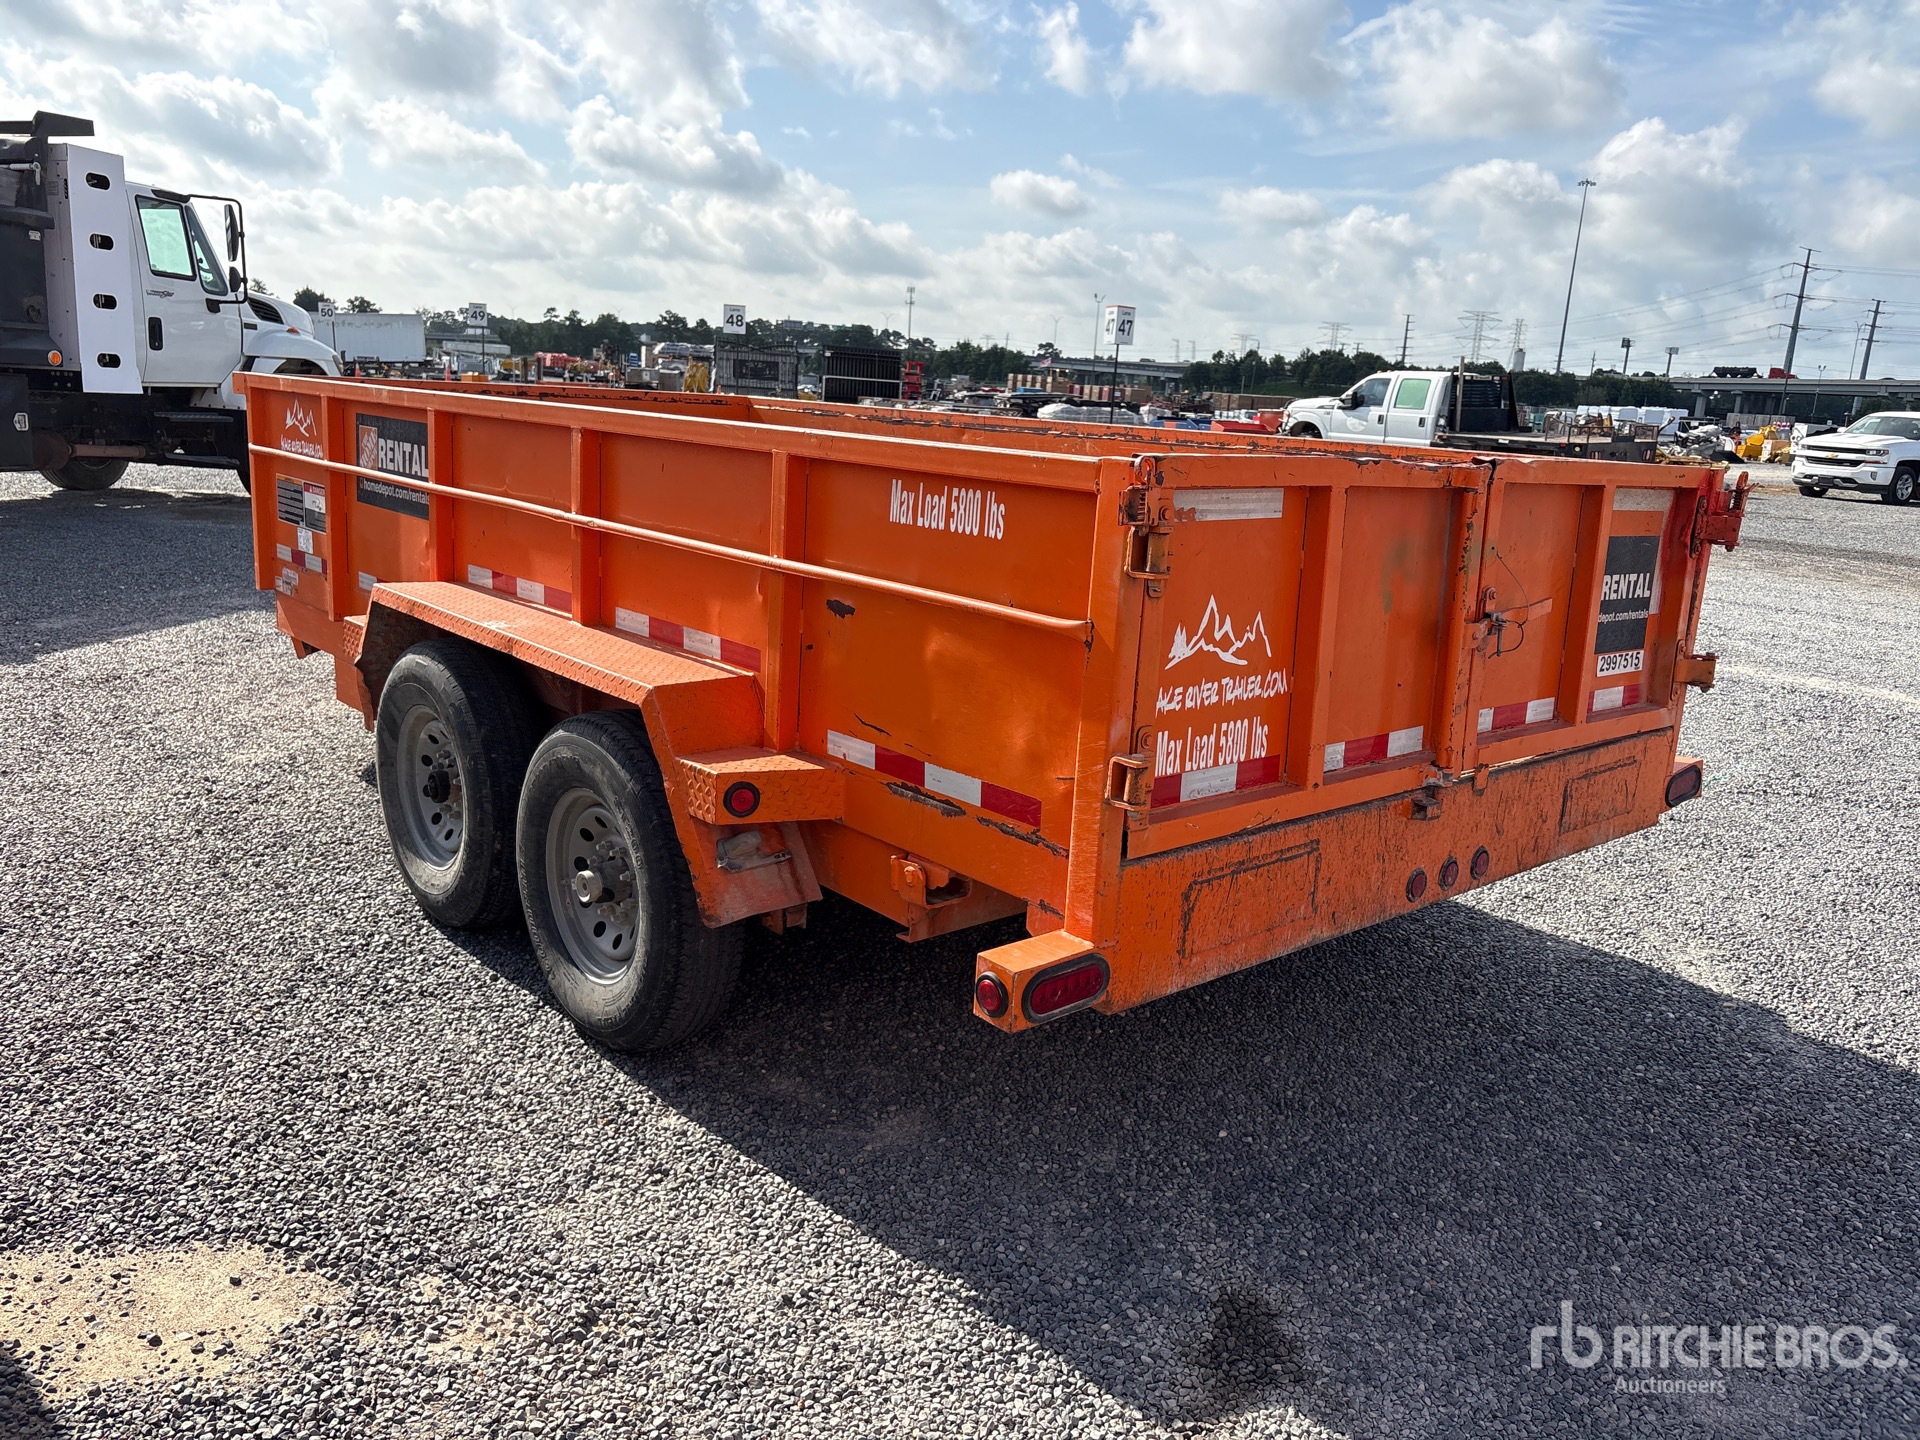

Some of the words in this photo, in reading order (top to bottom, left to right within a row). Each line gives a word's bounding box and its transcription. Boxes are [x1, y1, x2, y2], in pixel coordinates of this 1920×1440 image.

[320, 308, 334, 317] 50
[470, 310, 486, 321] 49
[726, 314, 744, 327] 48
[1105, 318, 1115, 335] 47
[1118, 319, 1133, 336] 47
[378, 438, 429, 477] RENTAL
[889, 479, 915, 525] Max
[917, 482, 948, 530] Load
[950, 487, 981, 536] 5800
[984, 490, 1006, 540] lbs
[1601, 573, 1651, 600] RENTAL
[1599, 652, 1641, 673] 2997515
[1185, 677, 1219, 711] RIVER
[1221, 667, 1288, 706] TRAILER.COM
[1155, 730, 1183, 777] Max
[1185, 723, 1217, 772] Load
[1218, 718, 1248, 766] 5800
[1250, 716, 1269, 760] lbs
